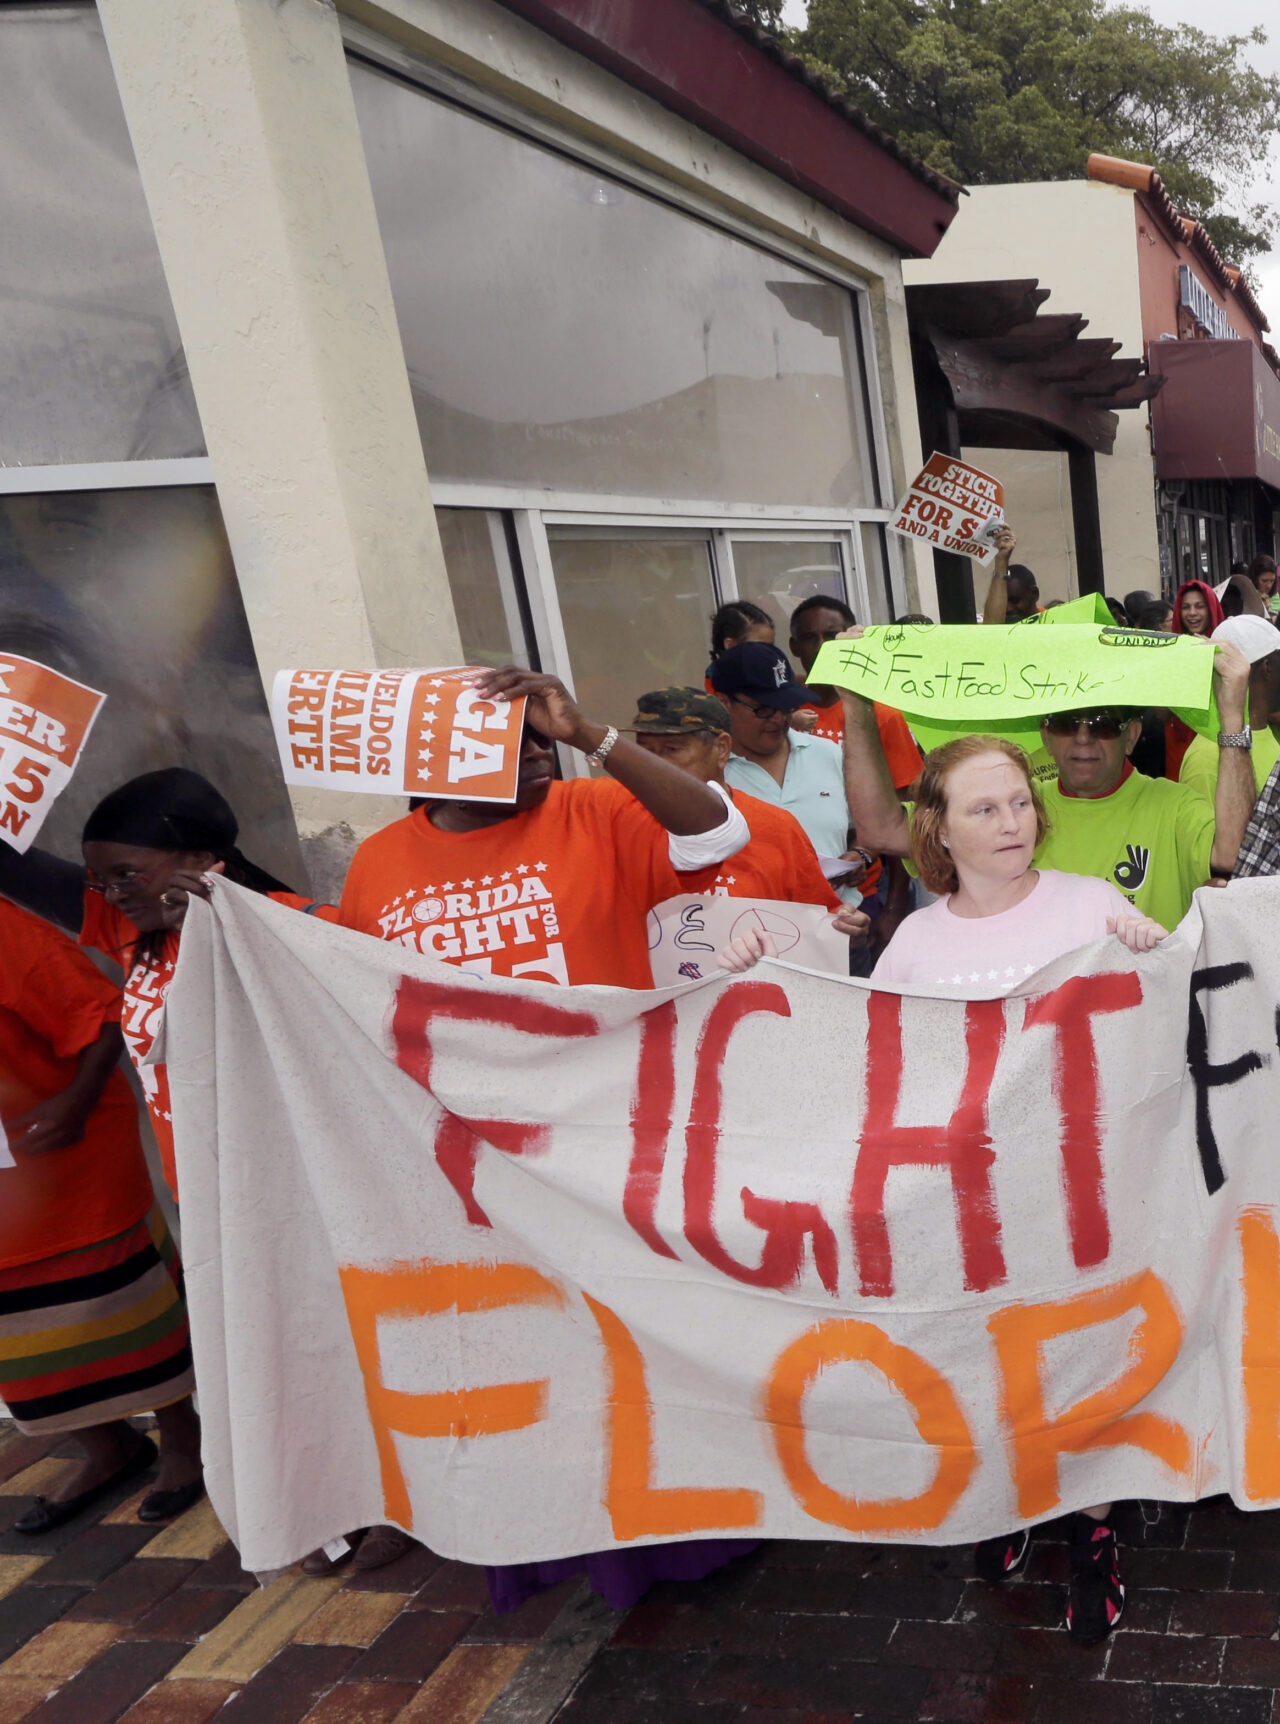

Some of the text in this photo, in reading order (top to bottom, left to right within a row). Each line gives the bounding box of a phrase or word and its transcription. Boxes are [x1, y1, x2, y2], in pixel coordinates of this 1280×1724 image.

[943, 464, 997, 502] STICK
[895, 516, 990, 560] AND A UNION
[901, 494, 953, 531] FOR
[367, 671, 409, 776] UELDOS
[448, 681, 512, 784] GA
[377, 876, 553, 940] FLORIDA
[540, 902, 560, 938] FOR
[392, 970, 1143, 1297] FIGHT
